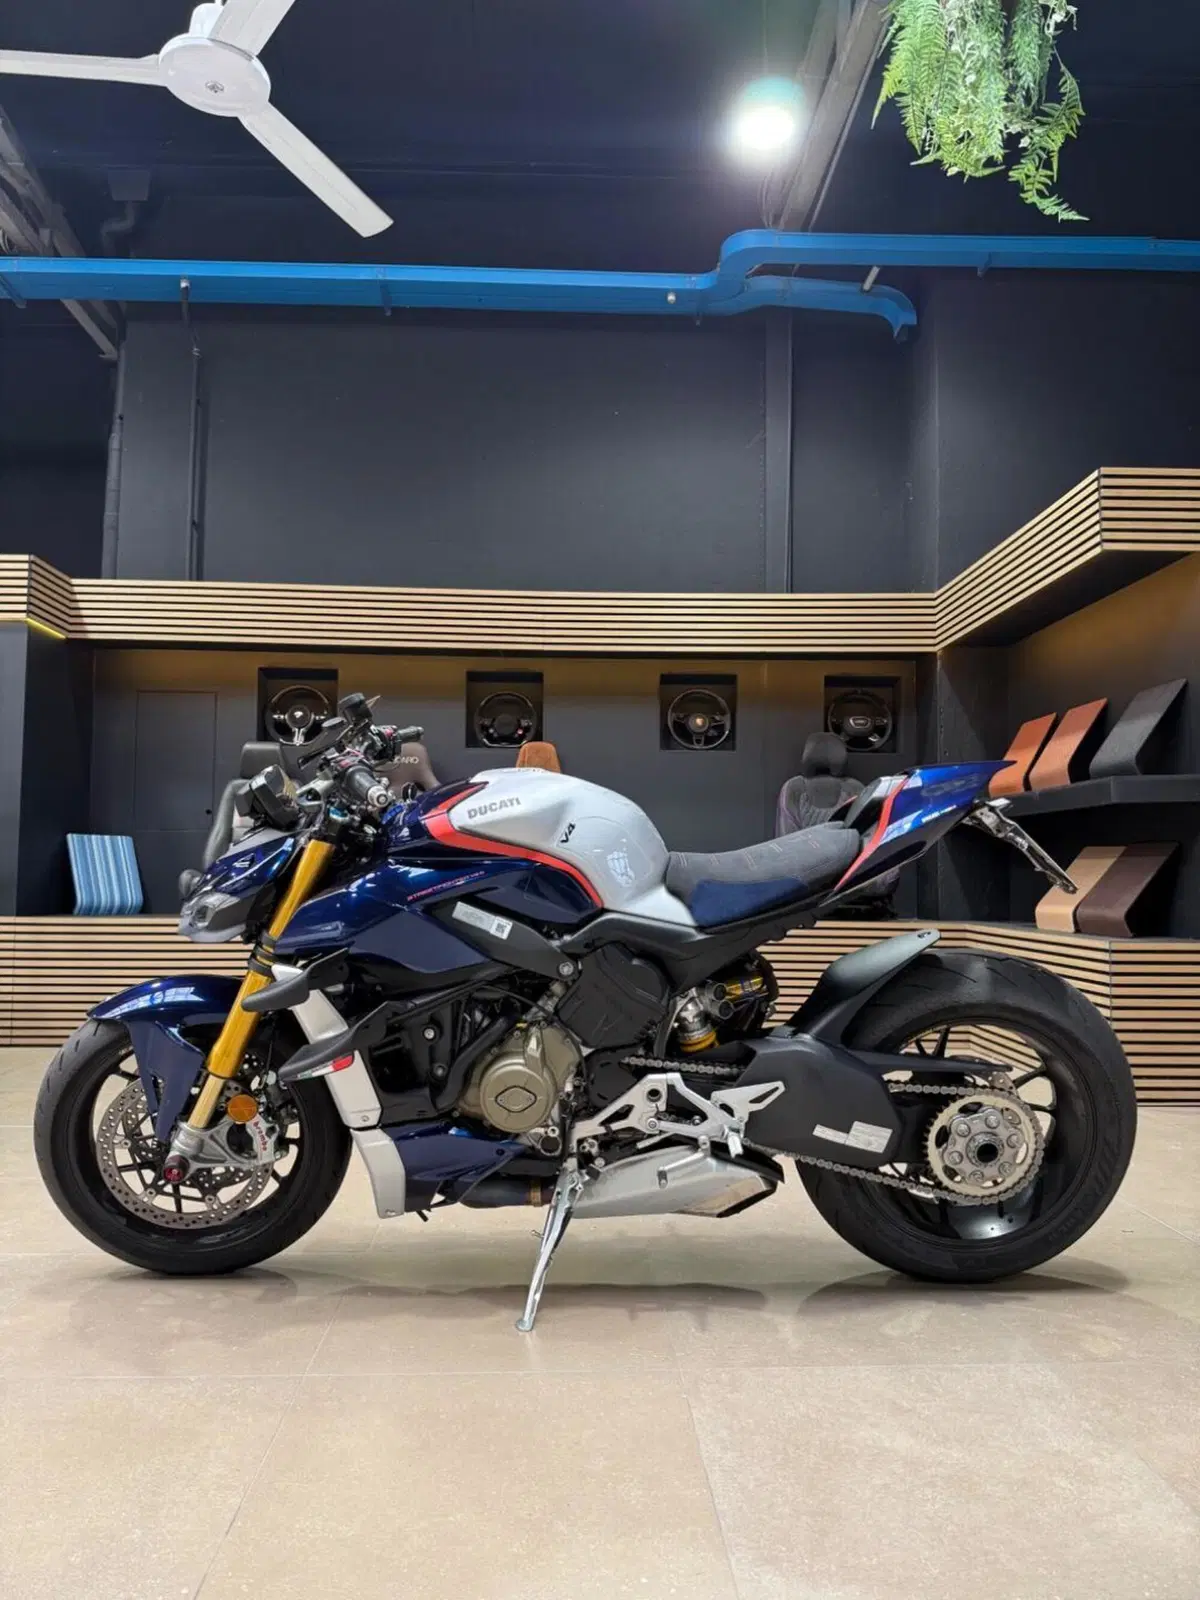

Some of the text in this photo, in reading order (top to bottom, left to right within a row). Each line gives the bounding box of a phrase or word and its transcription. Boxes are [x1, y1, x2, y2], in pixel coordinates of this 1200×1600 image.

[467, 797, 522, 820] DUCATI
[560, 822, 576, 844] V4
[253, 1121, 267, 1151] brembo
